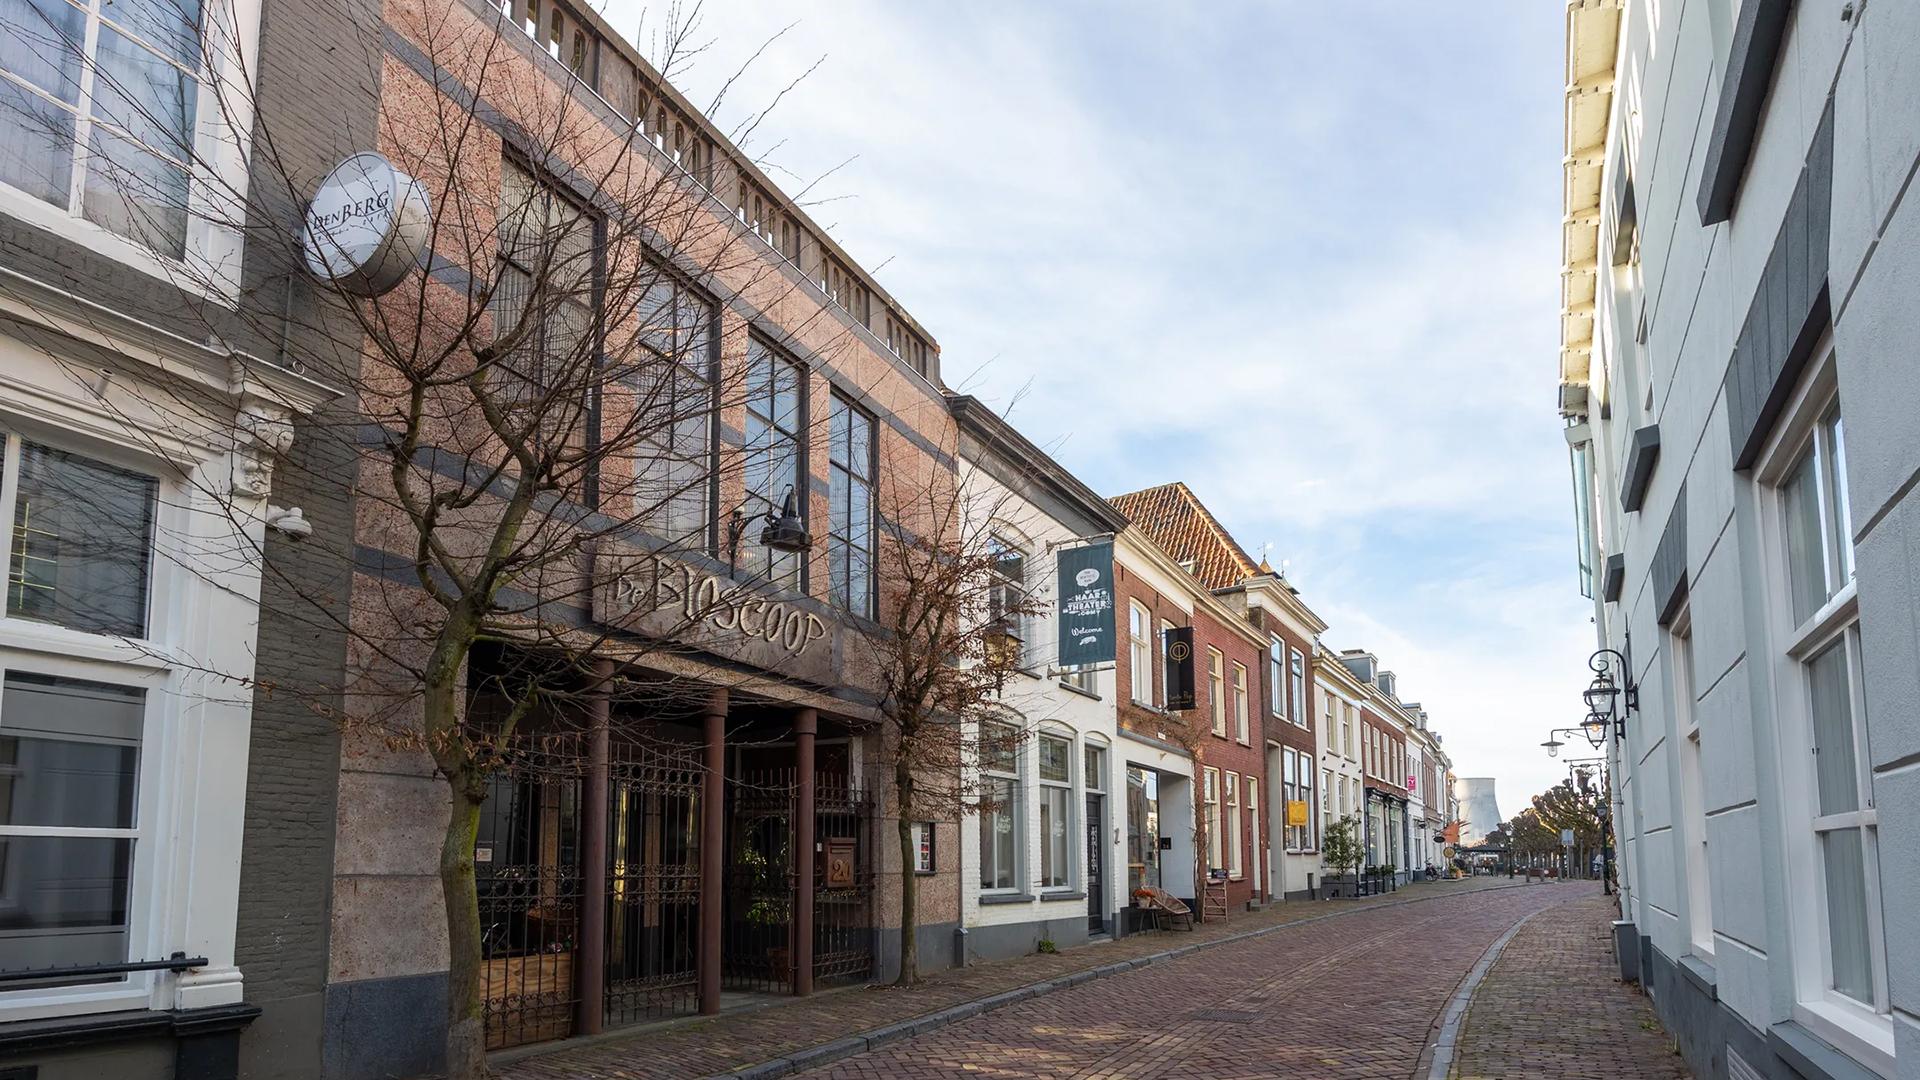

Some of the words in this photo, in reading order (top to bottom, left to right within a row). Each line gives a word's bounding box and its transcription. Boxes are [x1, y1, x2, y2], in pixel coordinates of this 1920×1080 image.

[1075, 593, 1101, 602] HAAR
[1067, 600, 1106, 611] THEATER
[1071, 626, 1103, 637] Welcome
